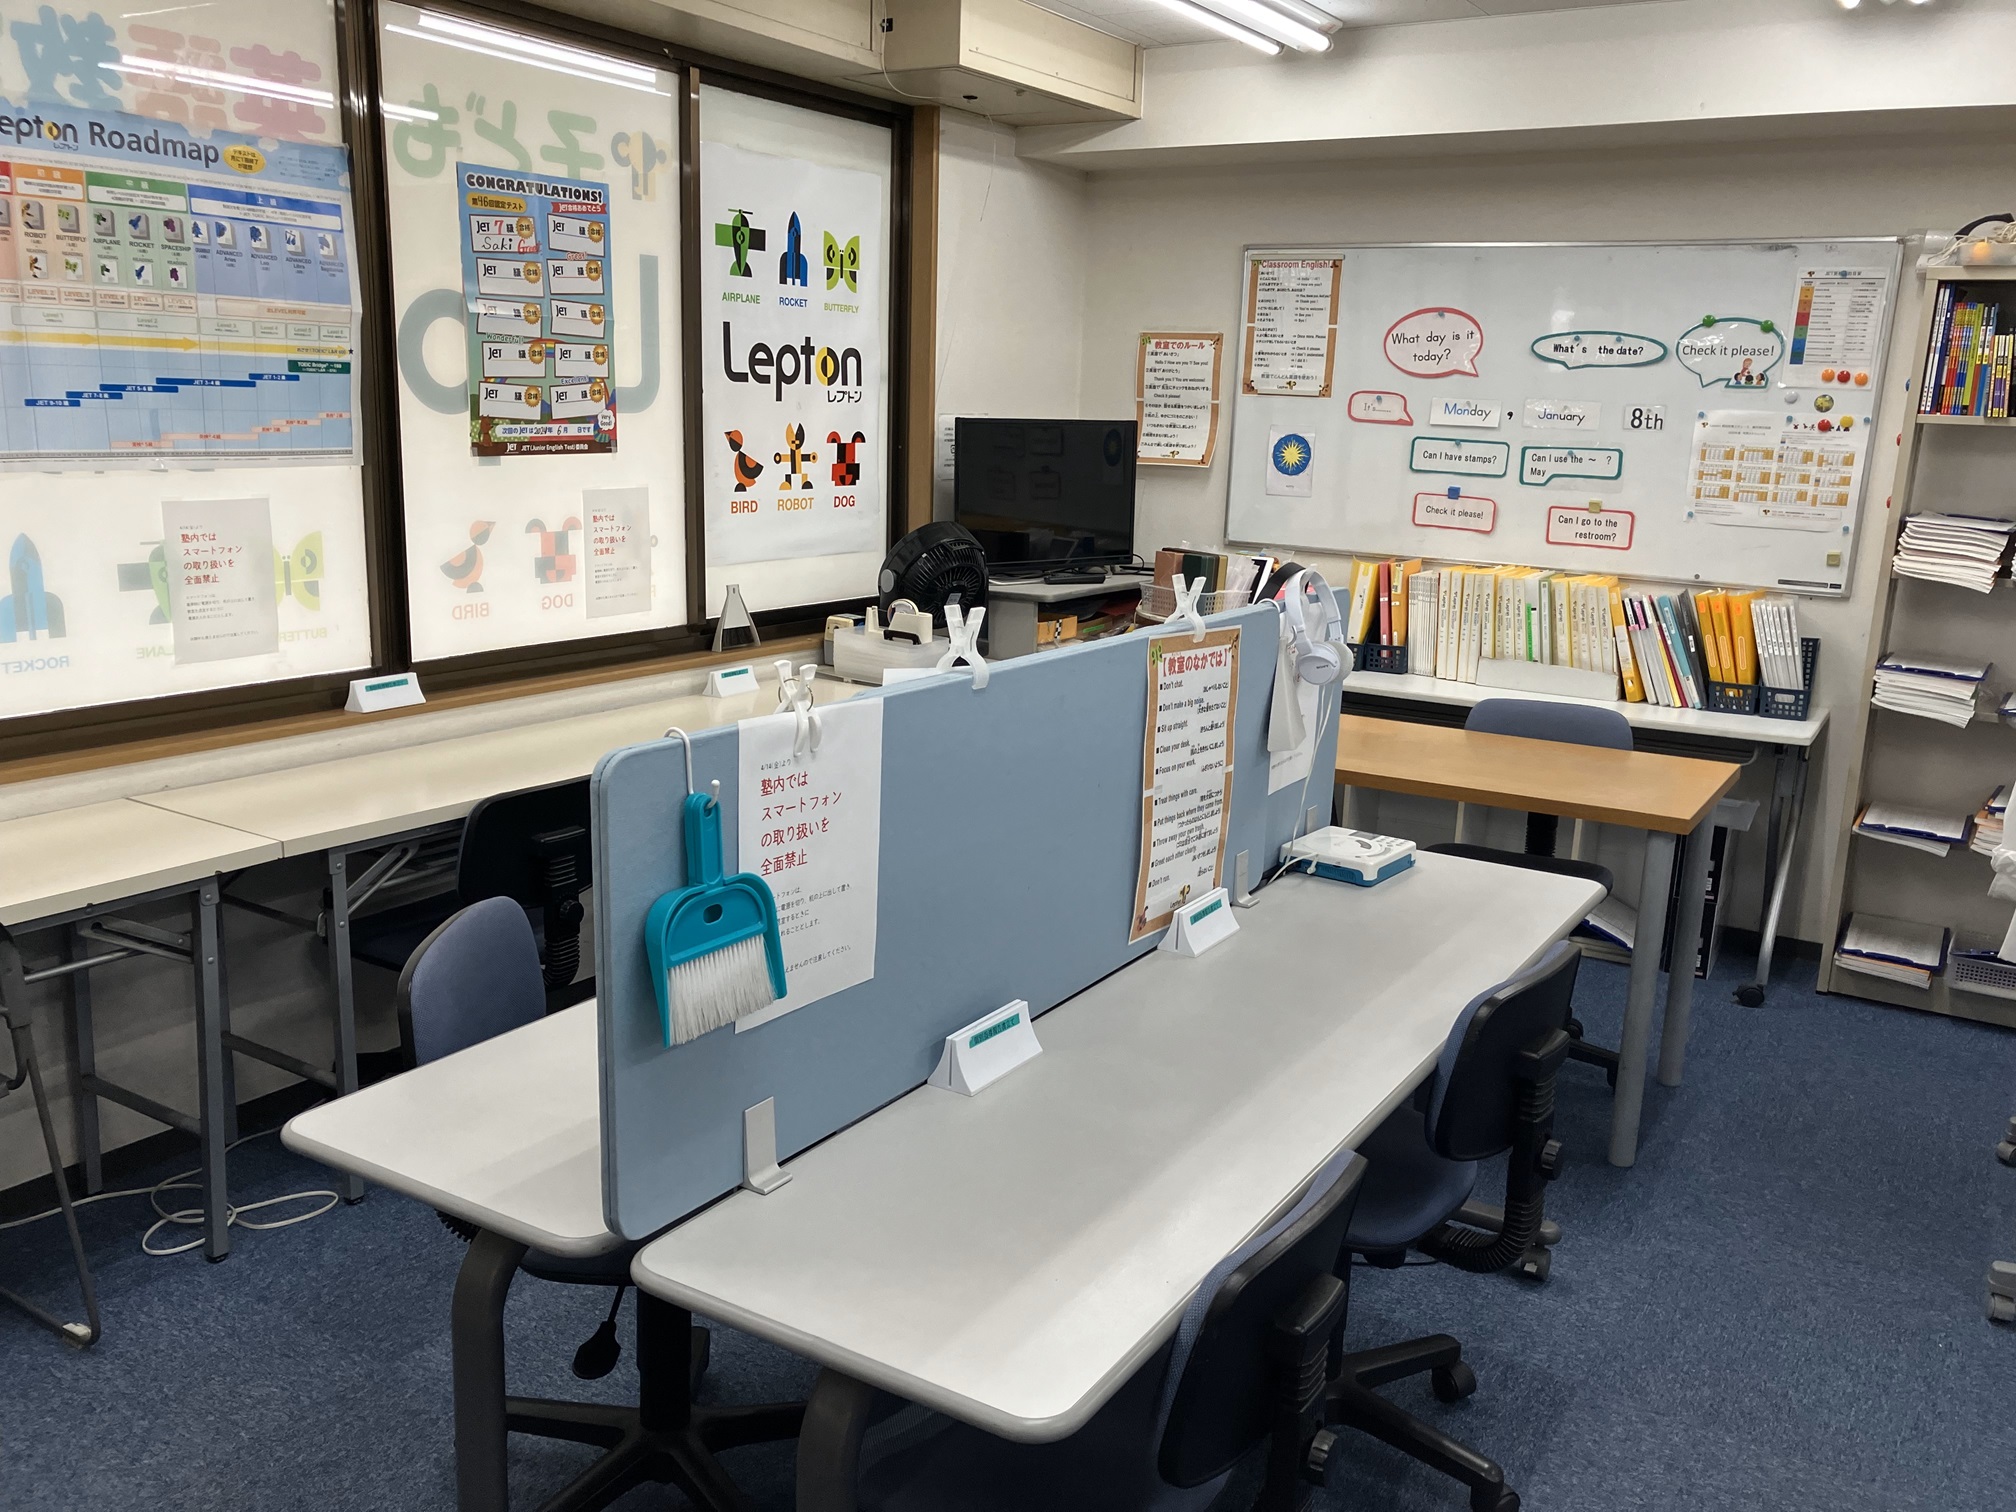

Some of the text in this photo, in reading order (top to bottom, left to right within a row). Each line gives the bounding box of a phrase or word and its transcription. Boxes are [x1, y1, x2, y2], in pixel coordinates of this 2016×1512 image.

[0, 114, 219, 168] epton Roadmap
[466, 173, 603, 203] CONGRATULATIONS!
[494, 219, 504, 236] 7
[24, 231, 47, 239] ROBOT
[56, 234, 87, 243] BUTTERFLY
[93, 238, 121, 246] AIRPLANE
[129, 241, 155, 249] ROCKET
[161, 244, 192, 252] SPACESHIP
[481, 236, 513, 251] Saki
[1262, 260, 1330, 270] Classroom English!
[721, 291, 761, 305] AIRPLANE
[778, 295, 808, 308] ROCKET
[823, 302, 860, 314] BUTTERFLY
[1391, 330, 1475, 346] What day is it
[1154, 340, 1206, 350] 教室でのルール
[1598, 344, 1615, 356] the
[1616, 345, 1644, 356] date?
[1682, 344, 1775, 359] Check it please!
[722, 321, 863, 402] Lepton
[1413, 348, 1451, 365] today?
[827, 389, 862, 404] レプトン
[1444, 402, 1492, 421] Monday
[1538, 409, 1586, 426] January
[1630, 408, 1664, 430] 8th
[546, 444, 564, 452] English
[1422, 450, 1498, 466] Can I have stamps?
[1531, 454, 1549, 464] Can
[1554, 456, 1568, 464] use
[1569, 454, 1584, 464] the
[1530, 466, 1546, 478] May
[730, 500, 759, 515] BIRD
[777, 497, 815, 512] ROBOT
[833, 495, 856, 508] DOG
[1426, 504, 1484, 520] Check it please!
[1558, 515, 1574, 526] Can
[1580, 518, 1592, 528] go
[1592, 518, 1602, 527] to
[1604, 518, 1618, 528] the
[593, 524, 632, 533] スマートフォン
[181, 532, 217, 544] 塾内では
[1574, 530, 1617, 542] restroom?
[183, 545, 243, 557] スマートフォン
[183, 558, 235, 571] の取り扱いを
[184, 573, 220, 586] 全面禁止
[1163, 648, 1228, 677] 【教室のなかでは】
[760, 770, 809, 797] 塾内では
[761, 791, 842, 822] スマートフォン
[760, 816, 830, 848] の取り扱いを
[760, 848, 808, 877] 全面禁止
